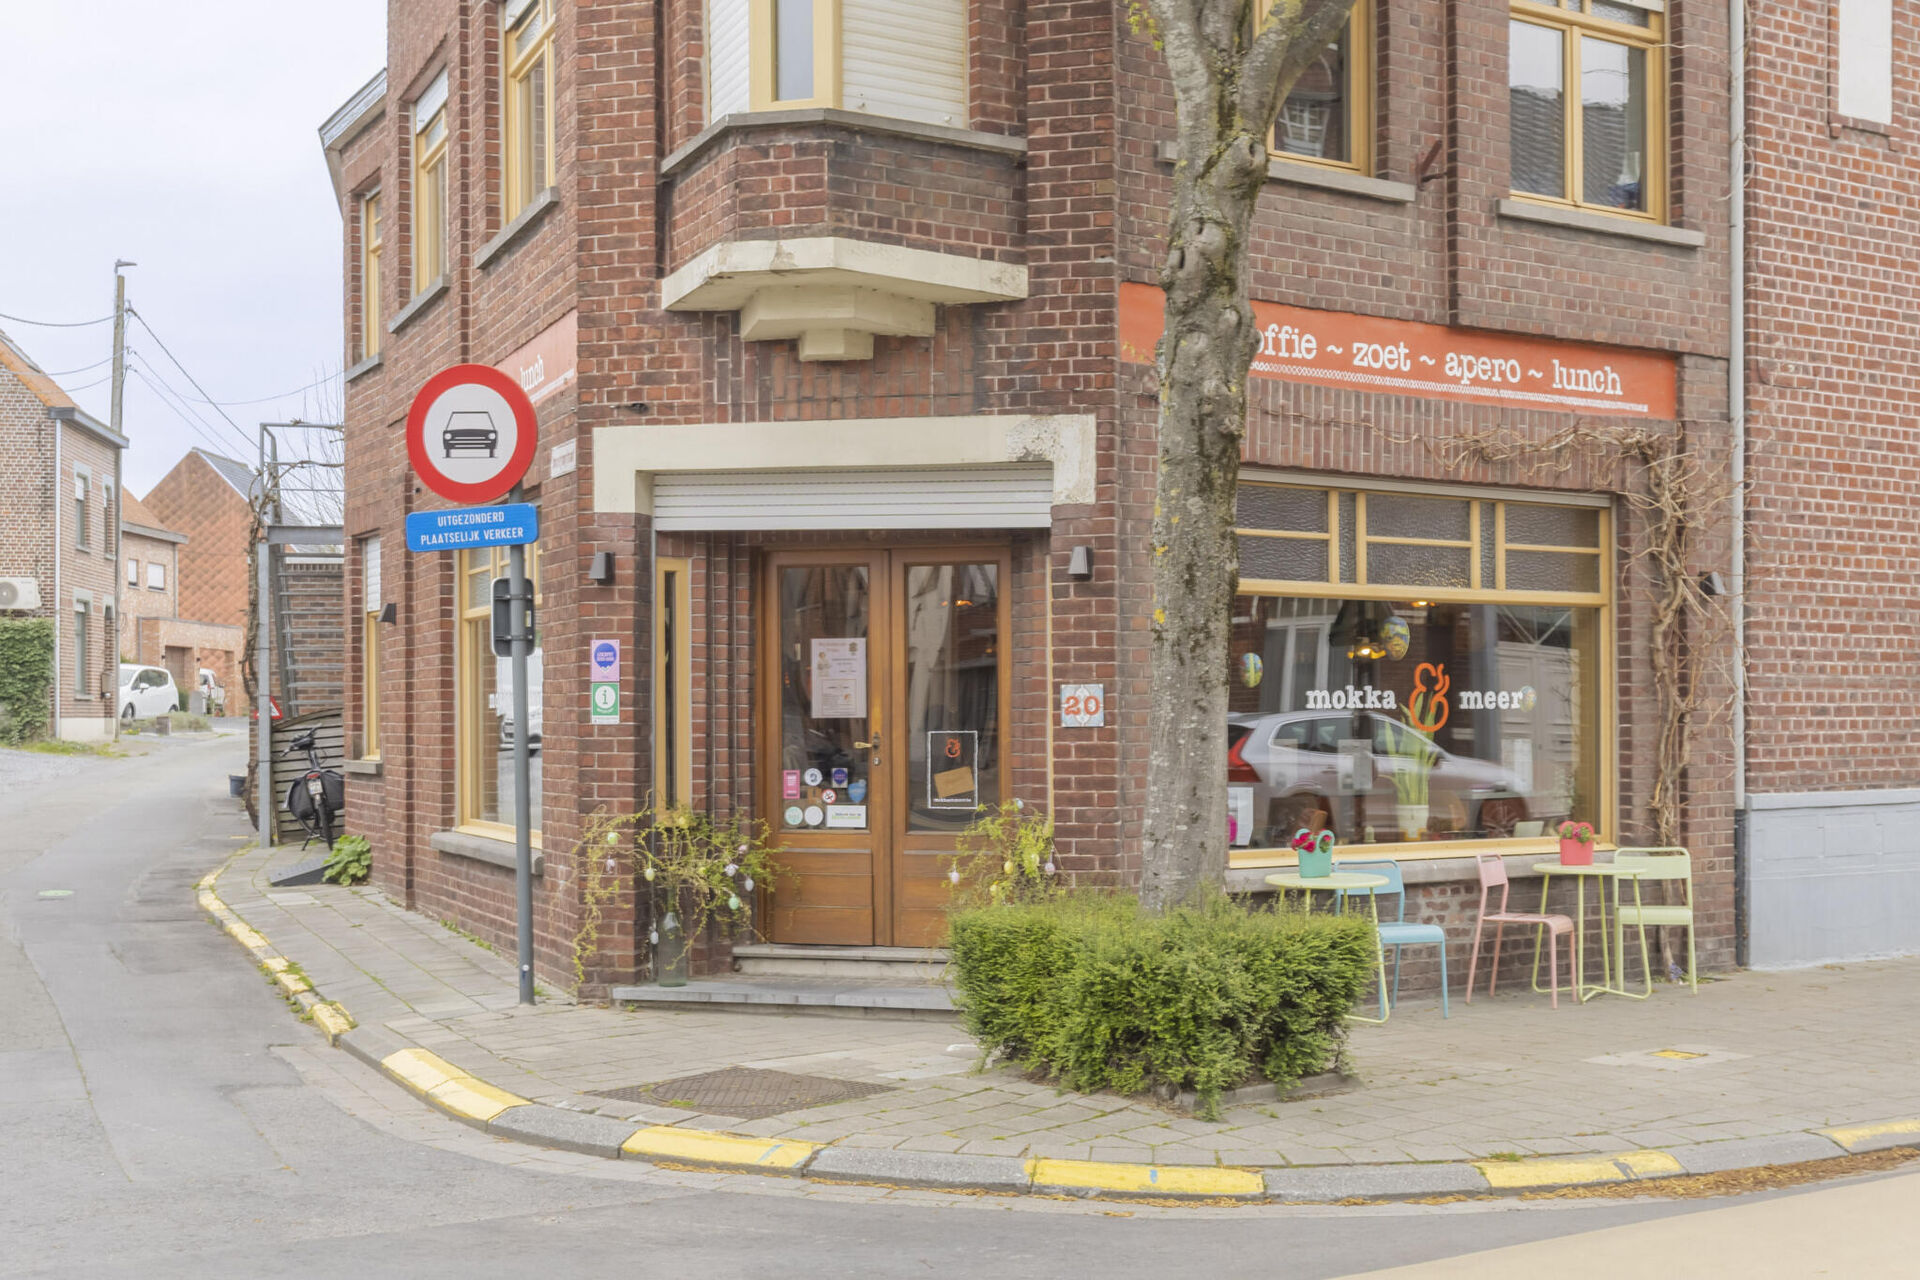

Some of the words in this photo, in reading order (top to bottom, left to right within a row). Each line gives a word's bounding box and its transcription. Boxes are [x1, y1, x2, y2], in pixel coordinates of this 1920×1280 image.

[1352, 341, 1411, 372] zoet
[1444, 352, 1521, 385] apero
[1552, 359, 1623, 395] lunch
[437, 511, 505, 527] UITGEZONDERD
[420, 531, 480, 545] PLAATSELIJK
[483, 527, 524, 540] VERKEER
[1064, 695, 1101, 716] 20
[1305, 685, 1397, 710] mokka
[1408, 662, 1450, 733] &
[1458, 690, 1523, 710] meer
